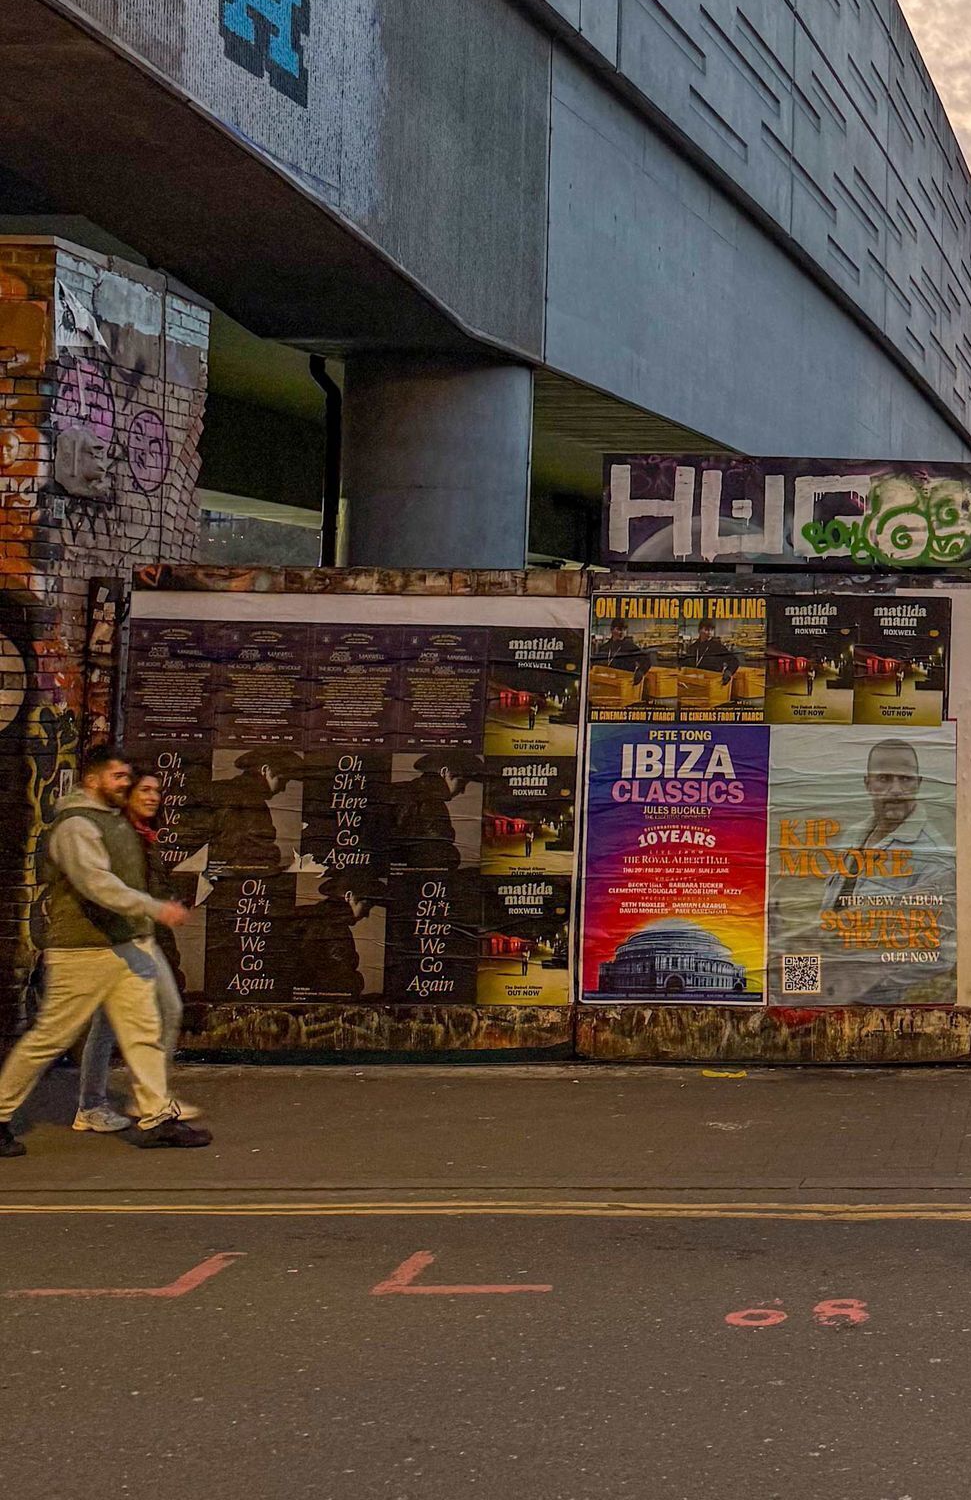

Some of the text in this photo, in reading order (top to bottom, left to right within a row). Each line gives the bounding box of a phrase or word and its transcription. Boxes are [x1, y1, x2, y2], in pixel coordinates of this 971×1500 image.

[595, 598, 680, 619] ON FALLING
[682, 598, 766, 620] ON FALLING
[784, 602, 838, 616] matilda
[873, 604, 927, 617] matilda
[791, 615, 828, 626] mann
[879, 616, 917, 627] mann
[508, 637, 564, 651] matilda
[514, 650, 553, 660] mann
[591, 711, 675, 721] IN CINEMAS FROM 7 MARCH
[680, 712, 764, 721] IN CINEMAS FROM 7 MARCH
[649, 730, 712, 741] PETE TONG
[157, 752, 181, 769] Oh
[338, 755, 362, 772] Oh
[621, 743, 736, 779] IBIZA
[502, 763, 558, 777] matilda
[509, 776, 548, 787] mann
[611, 780, 745, 804] CLASSICS
[330, 792, 368, 809] Here
[643, 806, 713, 815] JULES BUCKLEY
[336, 811, 362, 827] We
[155, 828, 178, 844] Go
[336, 830, 359, 846] Go
[638, 830, 716, 848] 10 YEARS
[779, 819, 840, 847] KIP
[323, 848, 370, 869] Again
[623, 855, 730, 865] THE ROYAL ALBERT HALL
[780, 849, 913, 879] MOORE
[241, 879, 266, 896] Oh
[421, 881, 446, 898] Oh
[497, 881, 553, 895] matilda
[504, 895, 543, 905] mann
[839, 895, 944, 906] THE NEW ALBUM
[508, 907, 543, 915] ROXWELL
[233, 917, 272, 933] Here
[413, 919, 452, 935] Here
[820, 909, 943, 932] SOLITARY
[240, 936, 266, 952] We
[419, 938, 446, 954] We
[836, 928, 941, 949] TRACKS
[240, 954, 264, 971] Go
[420, 956, 443, 973] Go
[881, 952, 940, 963] OUT NOW
[226, 973, 275, 996] Again
[406, 975, 454, 997] Again
